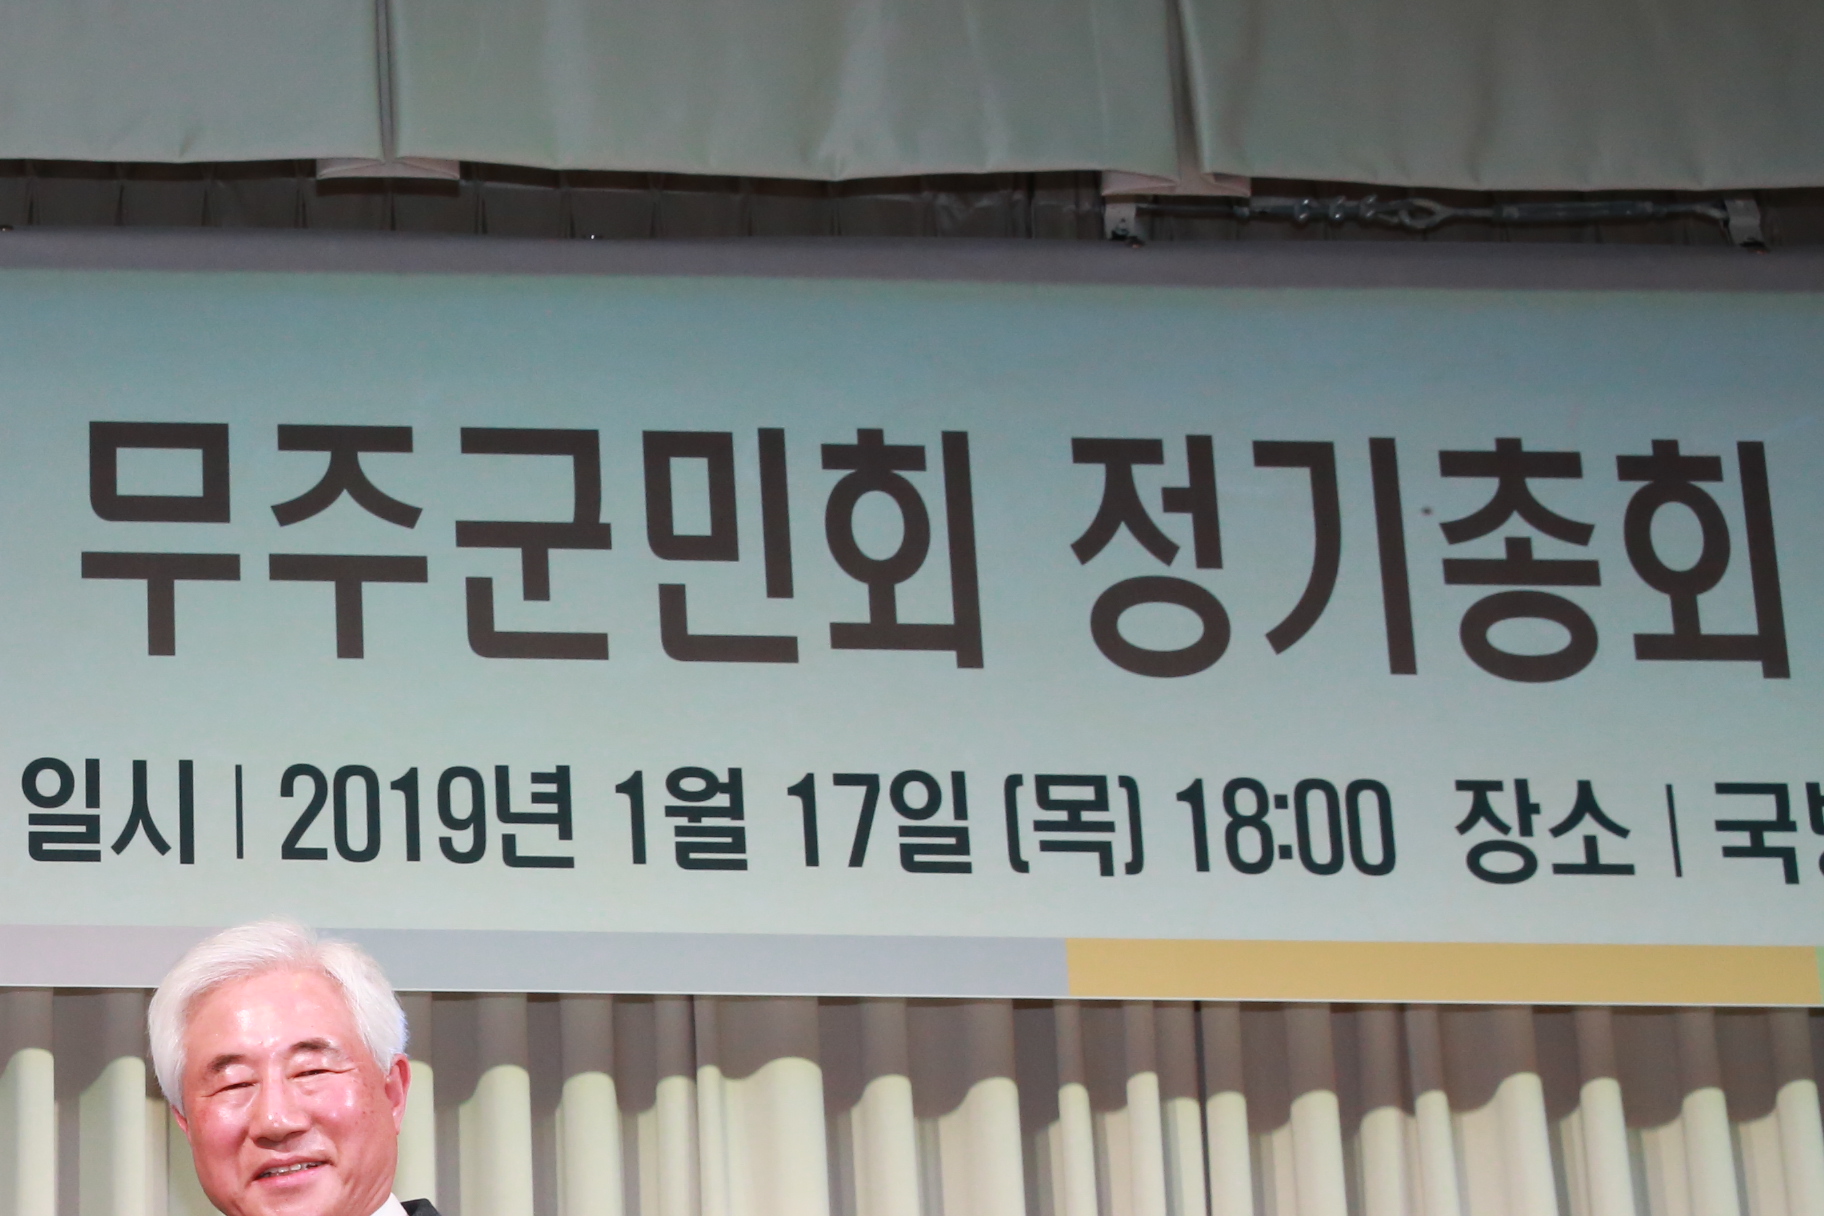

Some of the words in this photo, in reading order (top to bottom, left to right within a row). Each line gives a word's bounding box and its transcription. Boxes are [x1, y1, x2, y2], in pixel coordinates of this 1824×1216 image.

[82, 422, 983, 668] 무주군민회
[1071, 435, 1790, 682] 정기총회
[22, 757, 194, 864] 일시
[280, 764, 575, 869] 2019년
[615, 767, 748, 871] 1월
[787, 769, 972, 874] 17일
[1004, 774, 1144, 876] (목)
[1176, 777, 1396, 876] 18:00
[1456, 778, 1635, 884] 장소
